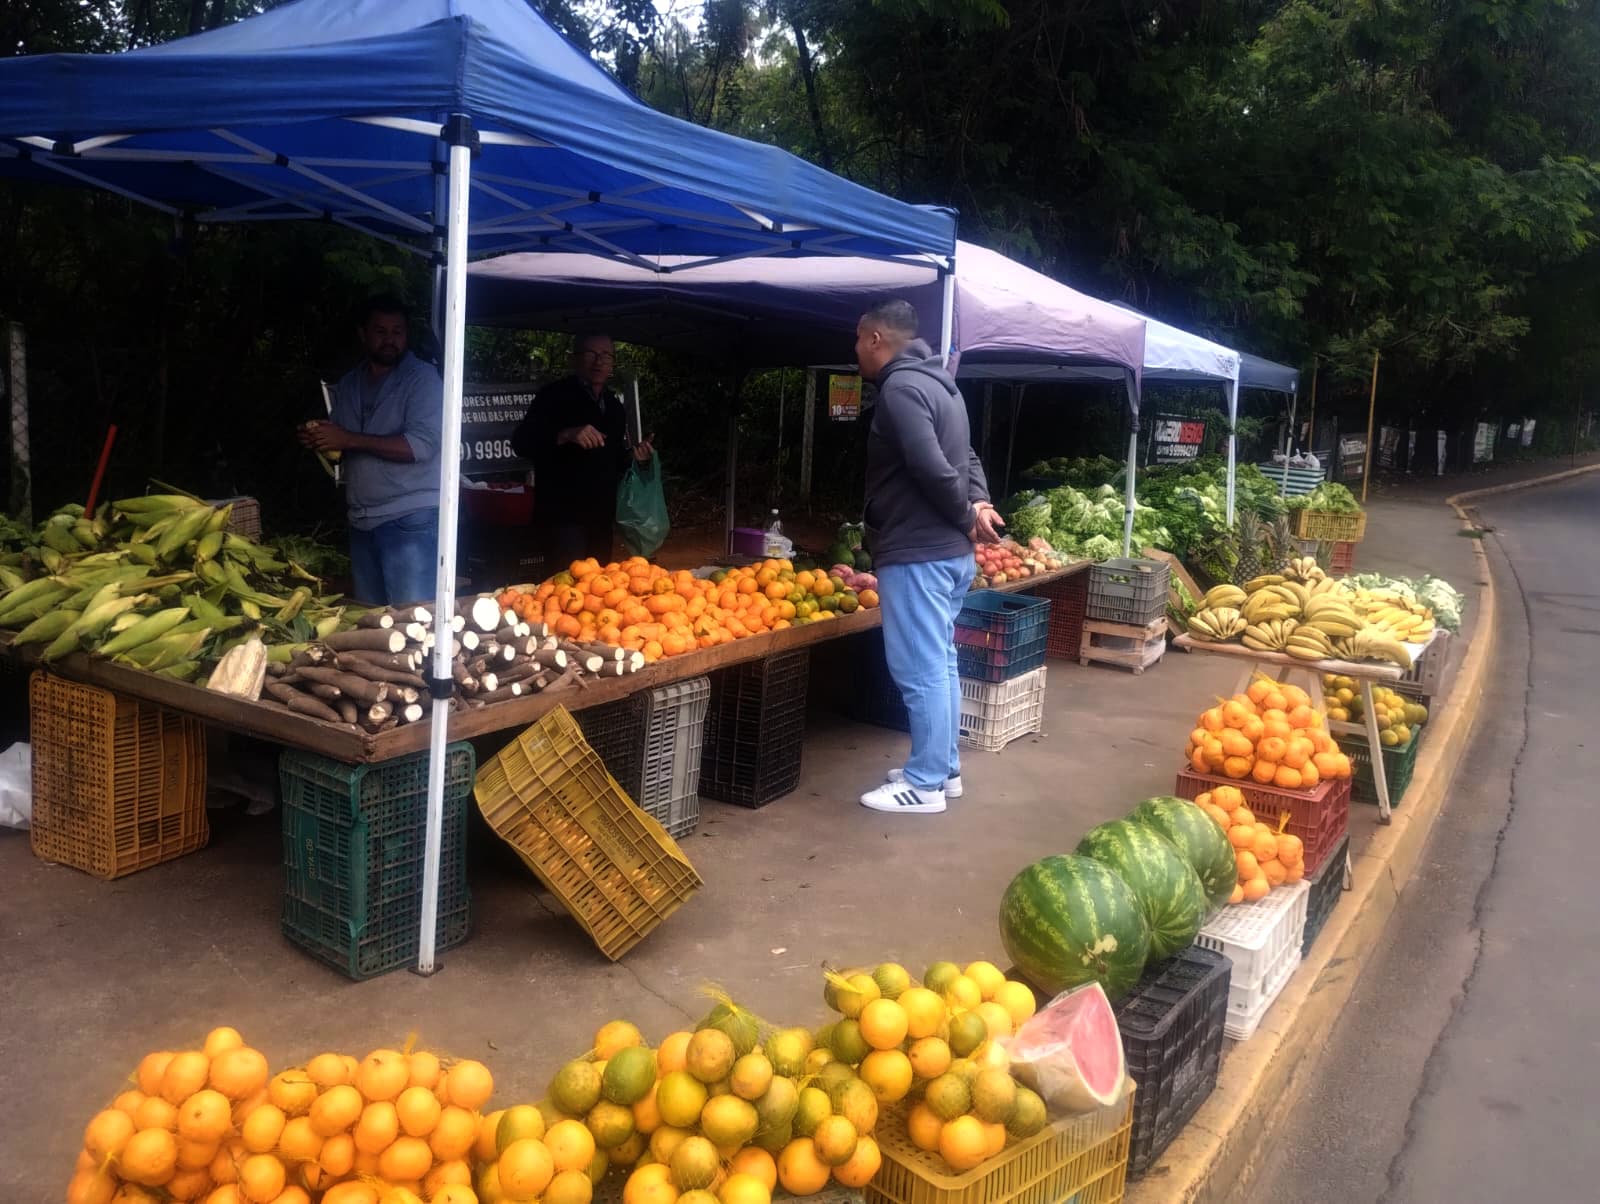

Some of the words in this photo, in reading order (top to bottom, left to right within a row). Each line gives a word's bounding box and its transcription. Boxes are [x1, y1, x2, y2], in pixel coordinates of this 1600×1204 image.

[487, 396, 492, 406] E
[493, 396, 513, 406] MAIS
[472, 412, 487, 422] RIO
